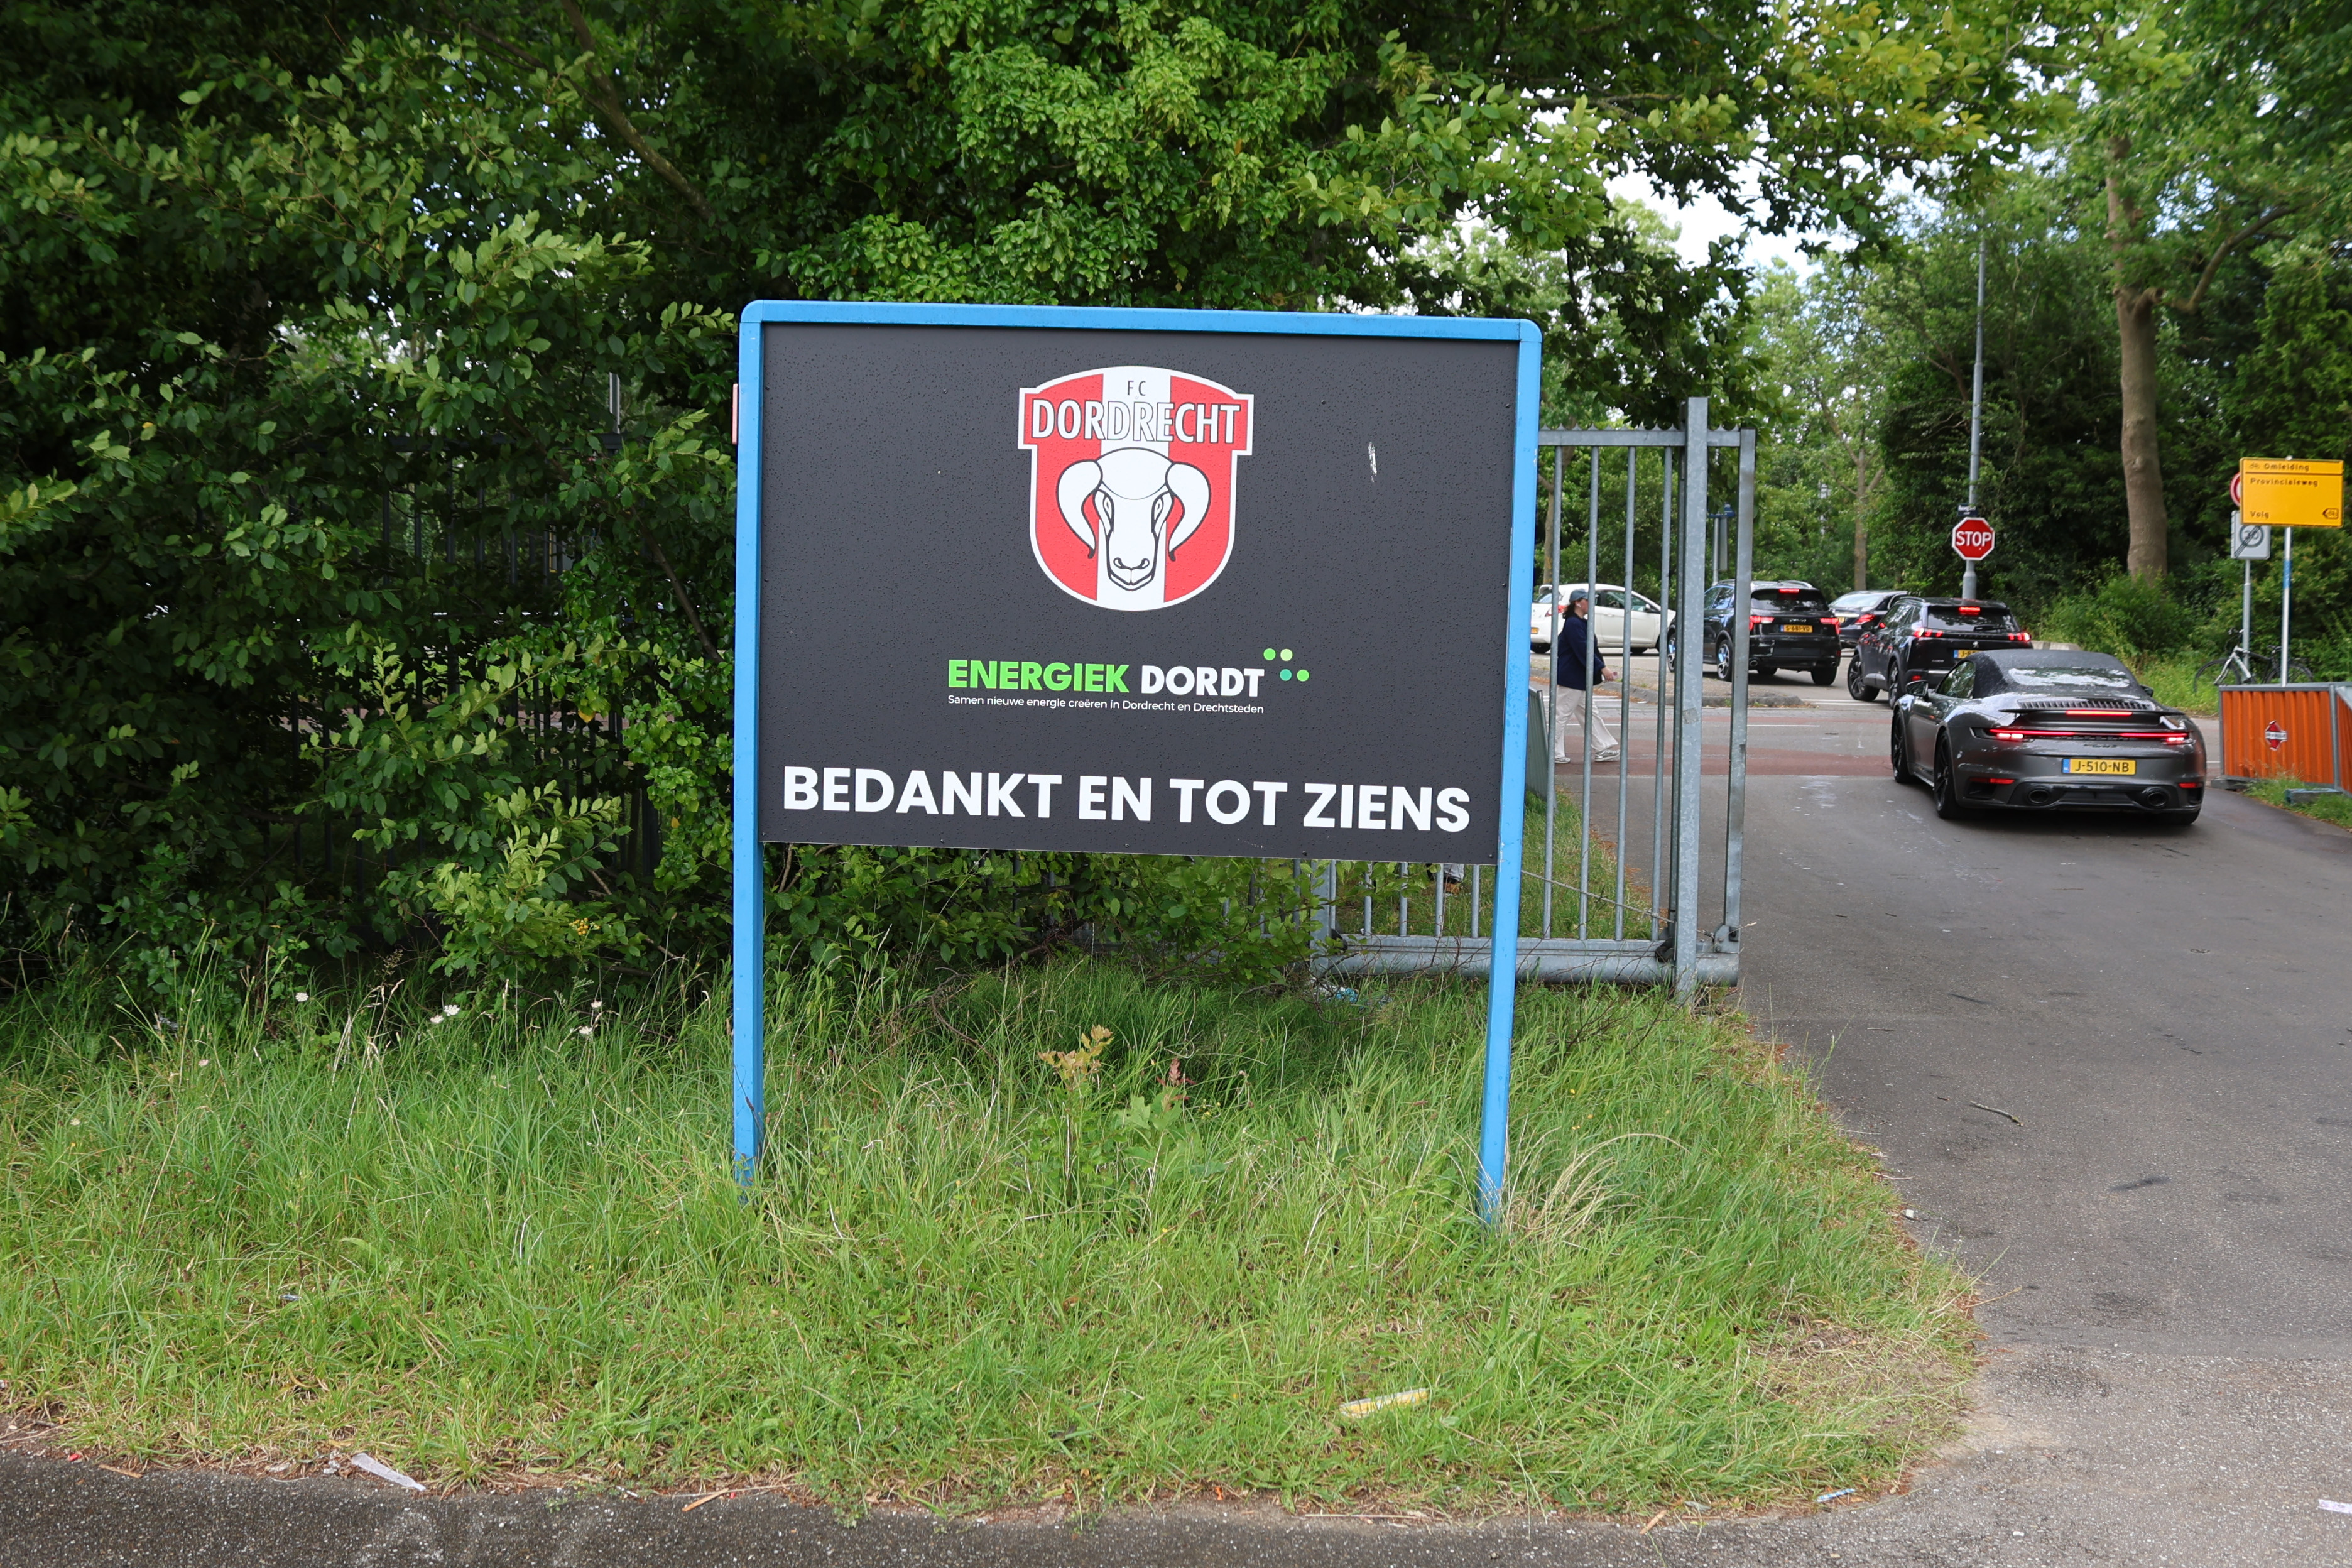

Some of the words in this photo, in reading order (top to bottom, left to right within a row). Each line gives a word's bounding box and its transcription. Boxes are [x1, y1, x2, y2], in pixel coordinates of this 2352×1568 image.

[1126, 379, 1146, 396] FC
[1031, 398, 1241, 444] DORDRECHT
[2263, 462, 2310, 472] Omleiding
[2250, 477, 2319, 487] Provincialeweg
[2250, 510, 2270, 519] Volg
[1956, 530, 1992, 547] STOP
[948, 660, 1130, 693] ENERGIEK
[1141, 665, 1265, 697] DORDT
[947, 695, 984, 705] Samen
[987, 696, 1025, 706] nieuwe
[1026, 698, 1066, 709] energie
[1068, 699, 1108, 709] creëren
[1110, 699, 1120, 709] in
[1123, 700, 1175, 711] Dordrecht
[1177, 702, 1191, 711] en
[1194, 702, 1265, 714] Drechtsteden
[2075, 761, 2130, 773] J-510-NB
[783, 766, 1063, 819] BEDANKT
[1079, 776, 1153, 823] EN
[1170, 778, 1289, 827] TOT
[1302, 783, 1471, 833] ZIENS
